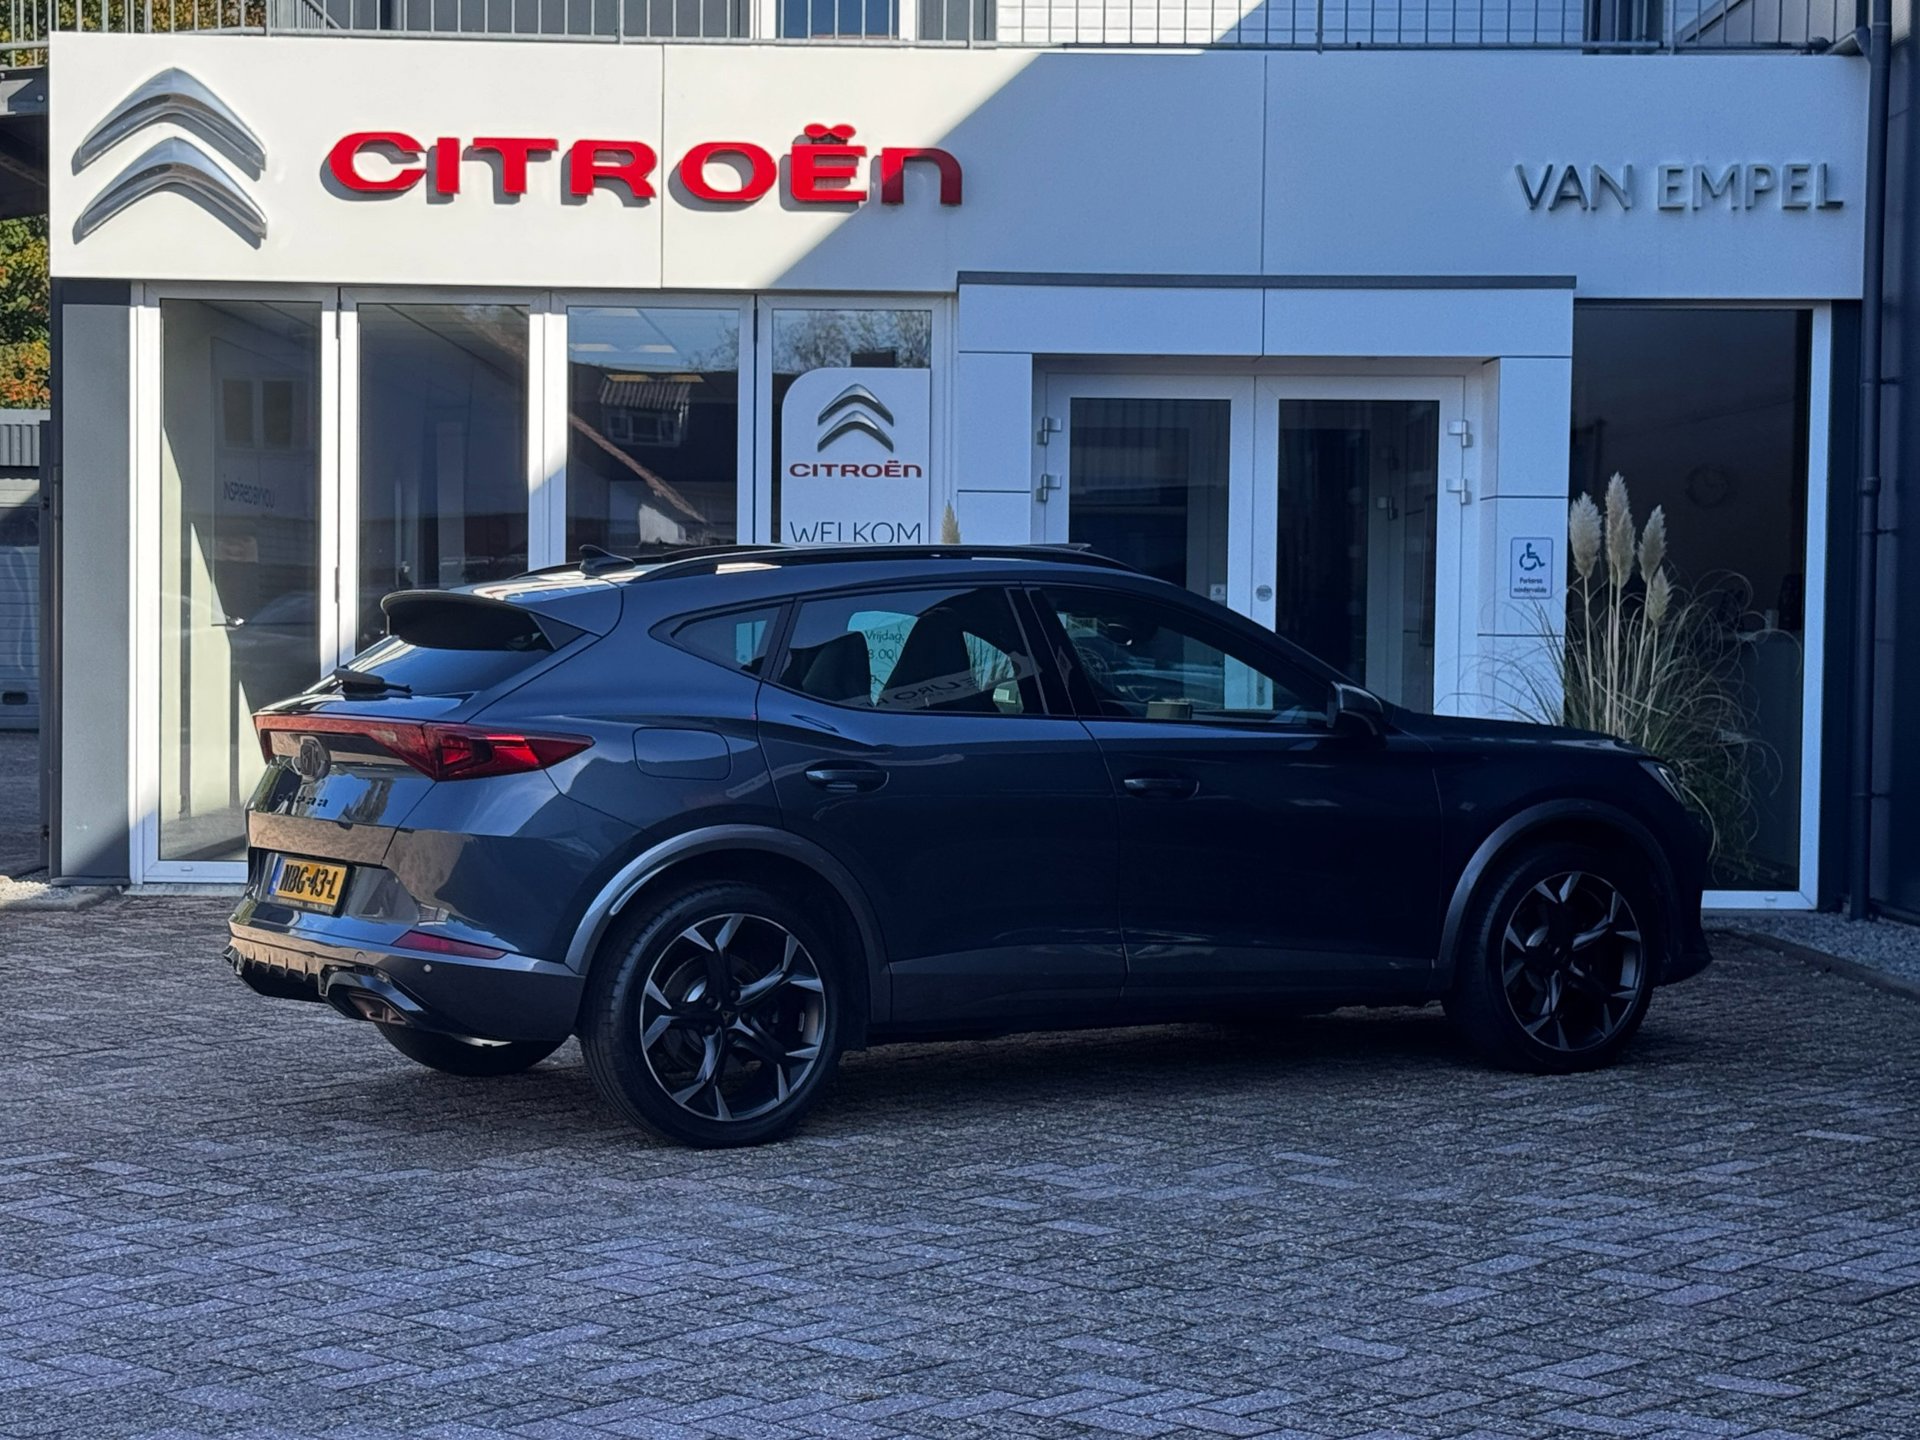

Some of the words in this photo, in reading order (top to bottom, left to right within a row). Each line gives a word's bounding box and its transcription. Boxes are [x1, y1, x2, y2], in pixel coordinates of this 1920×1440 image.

[1514, 163, 1633, 211] VAN
[1656, 163, 1844, 211] EMPEL
[279, 864, 339, 900] NBG-43-L
